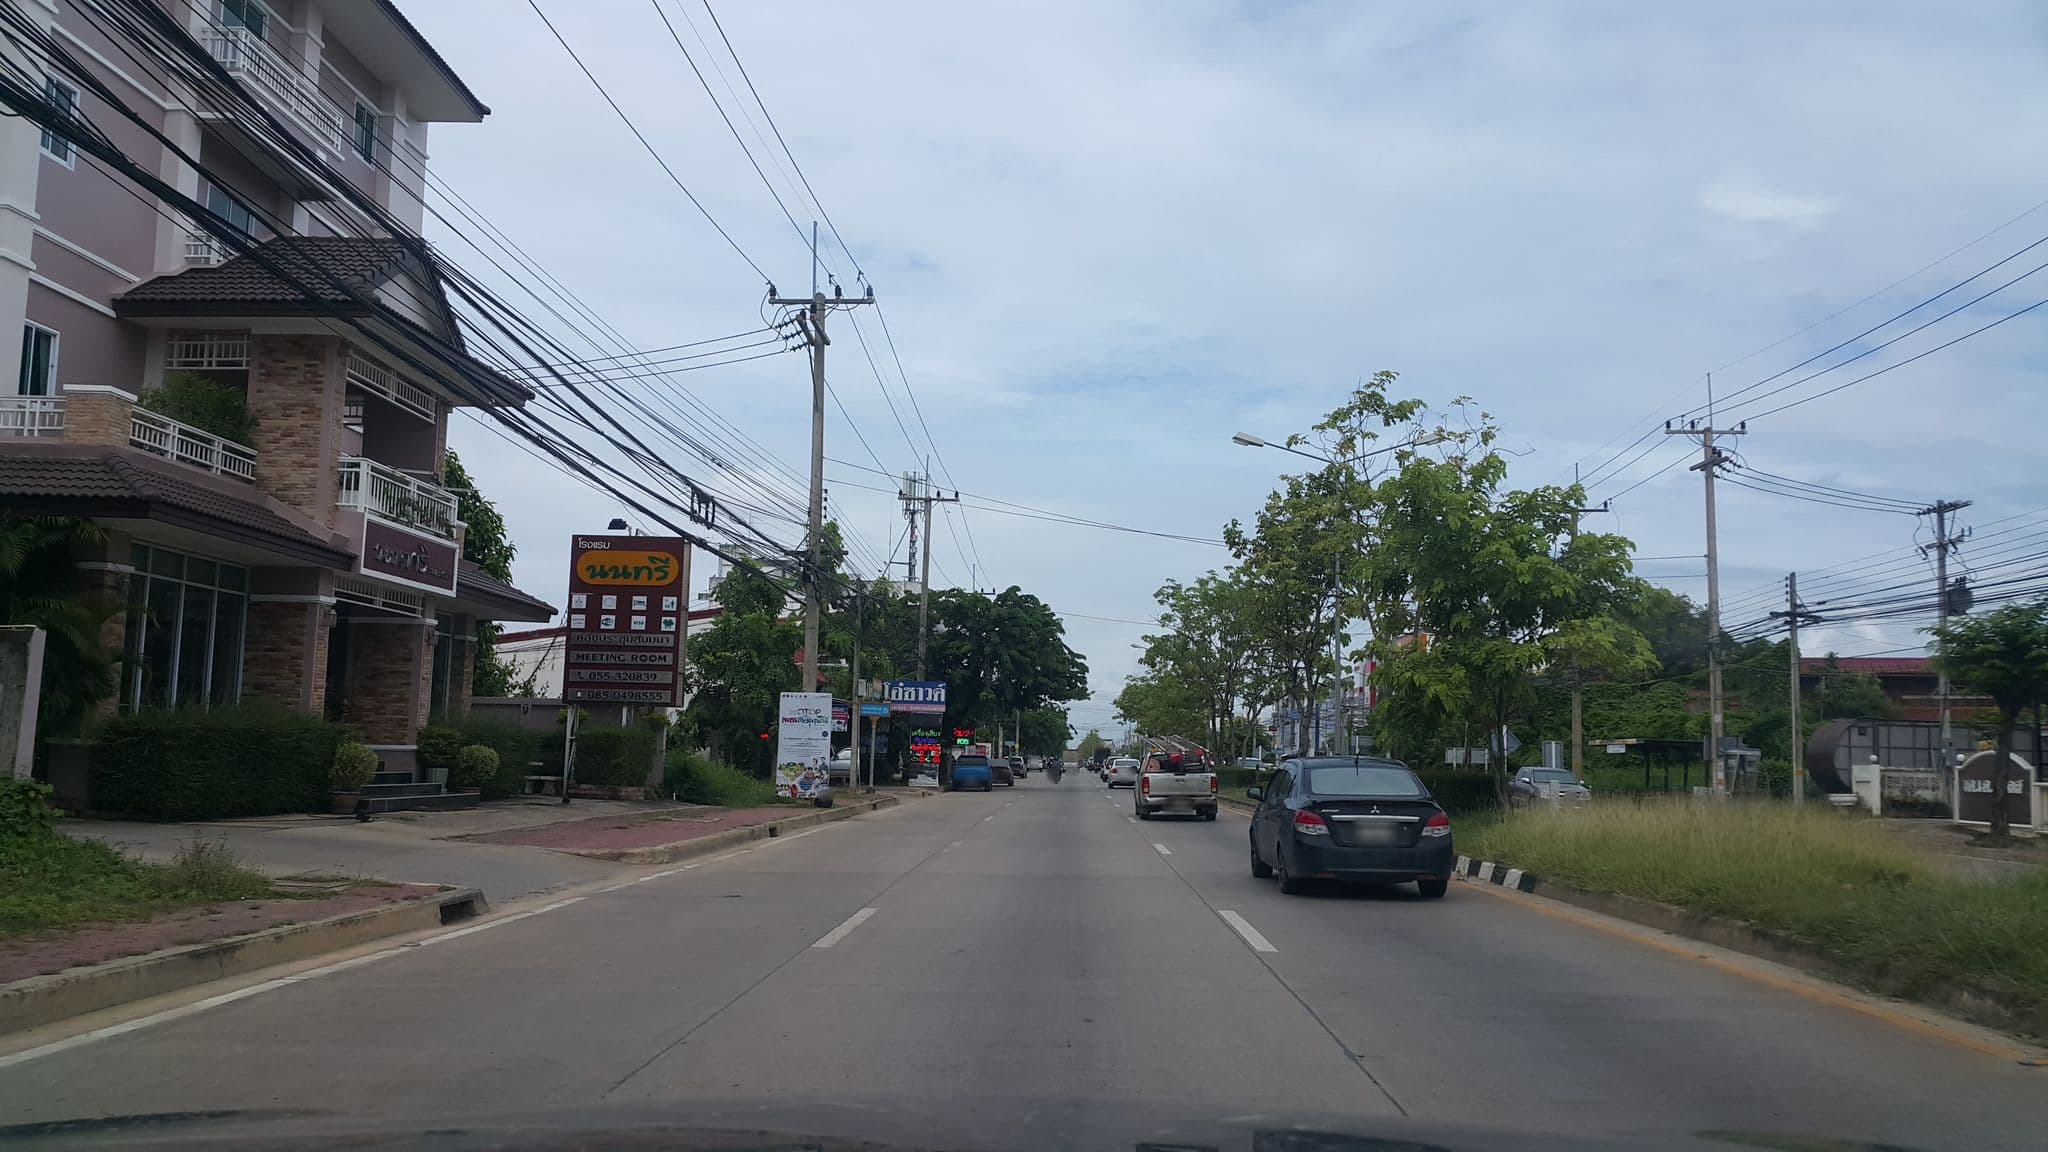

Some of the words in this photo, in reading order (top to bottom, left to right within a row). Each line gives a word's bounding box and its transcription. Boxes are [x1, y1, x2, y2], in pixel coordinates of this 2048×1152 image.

[578, 537, 610, 549] โรงแรม
[585, 556, 670, 581] นนทรี
[576, 652, 625, 663] MEETING
[631, 654, 667, 663] ROOM
